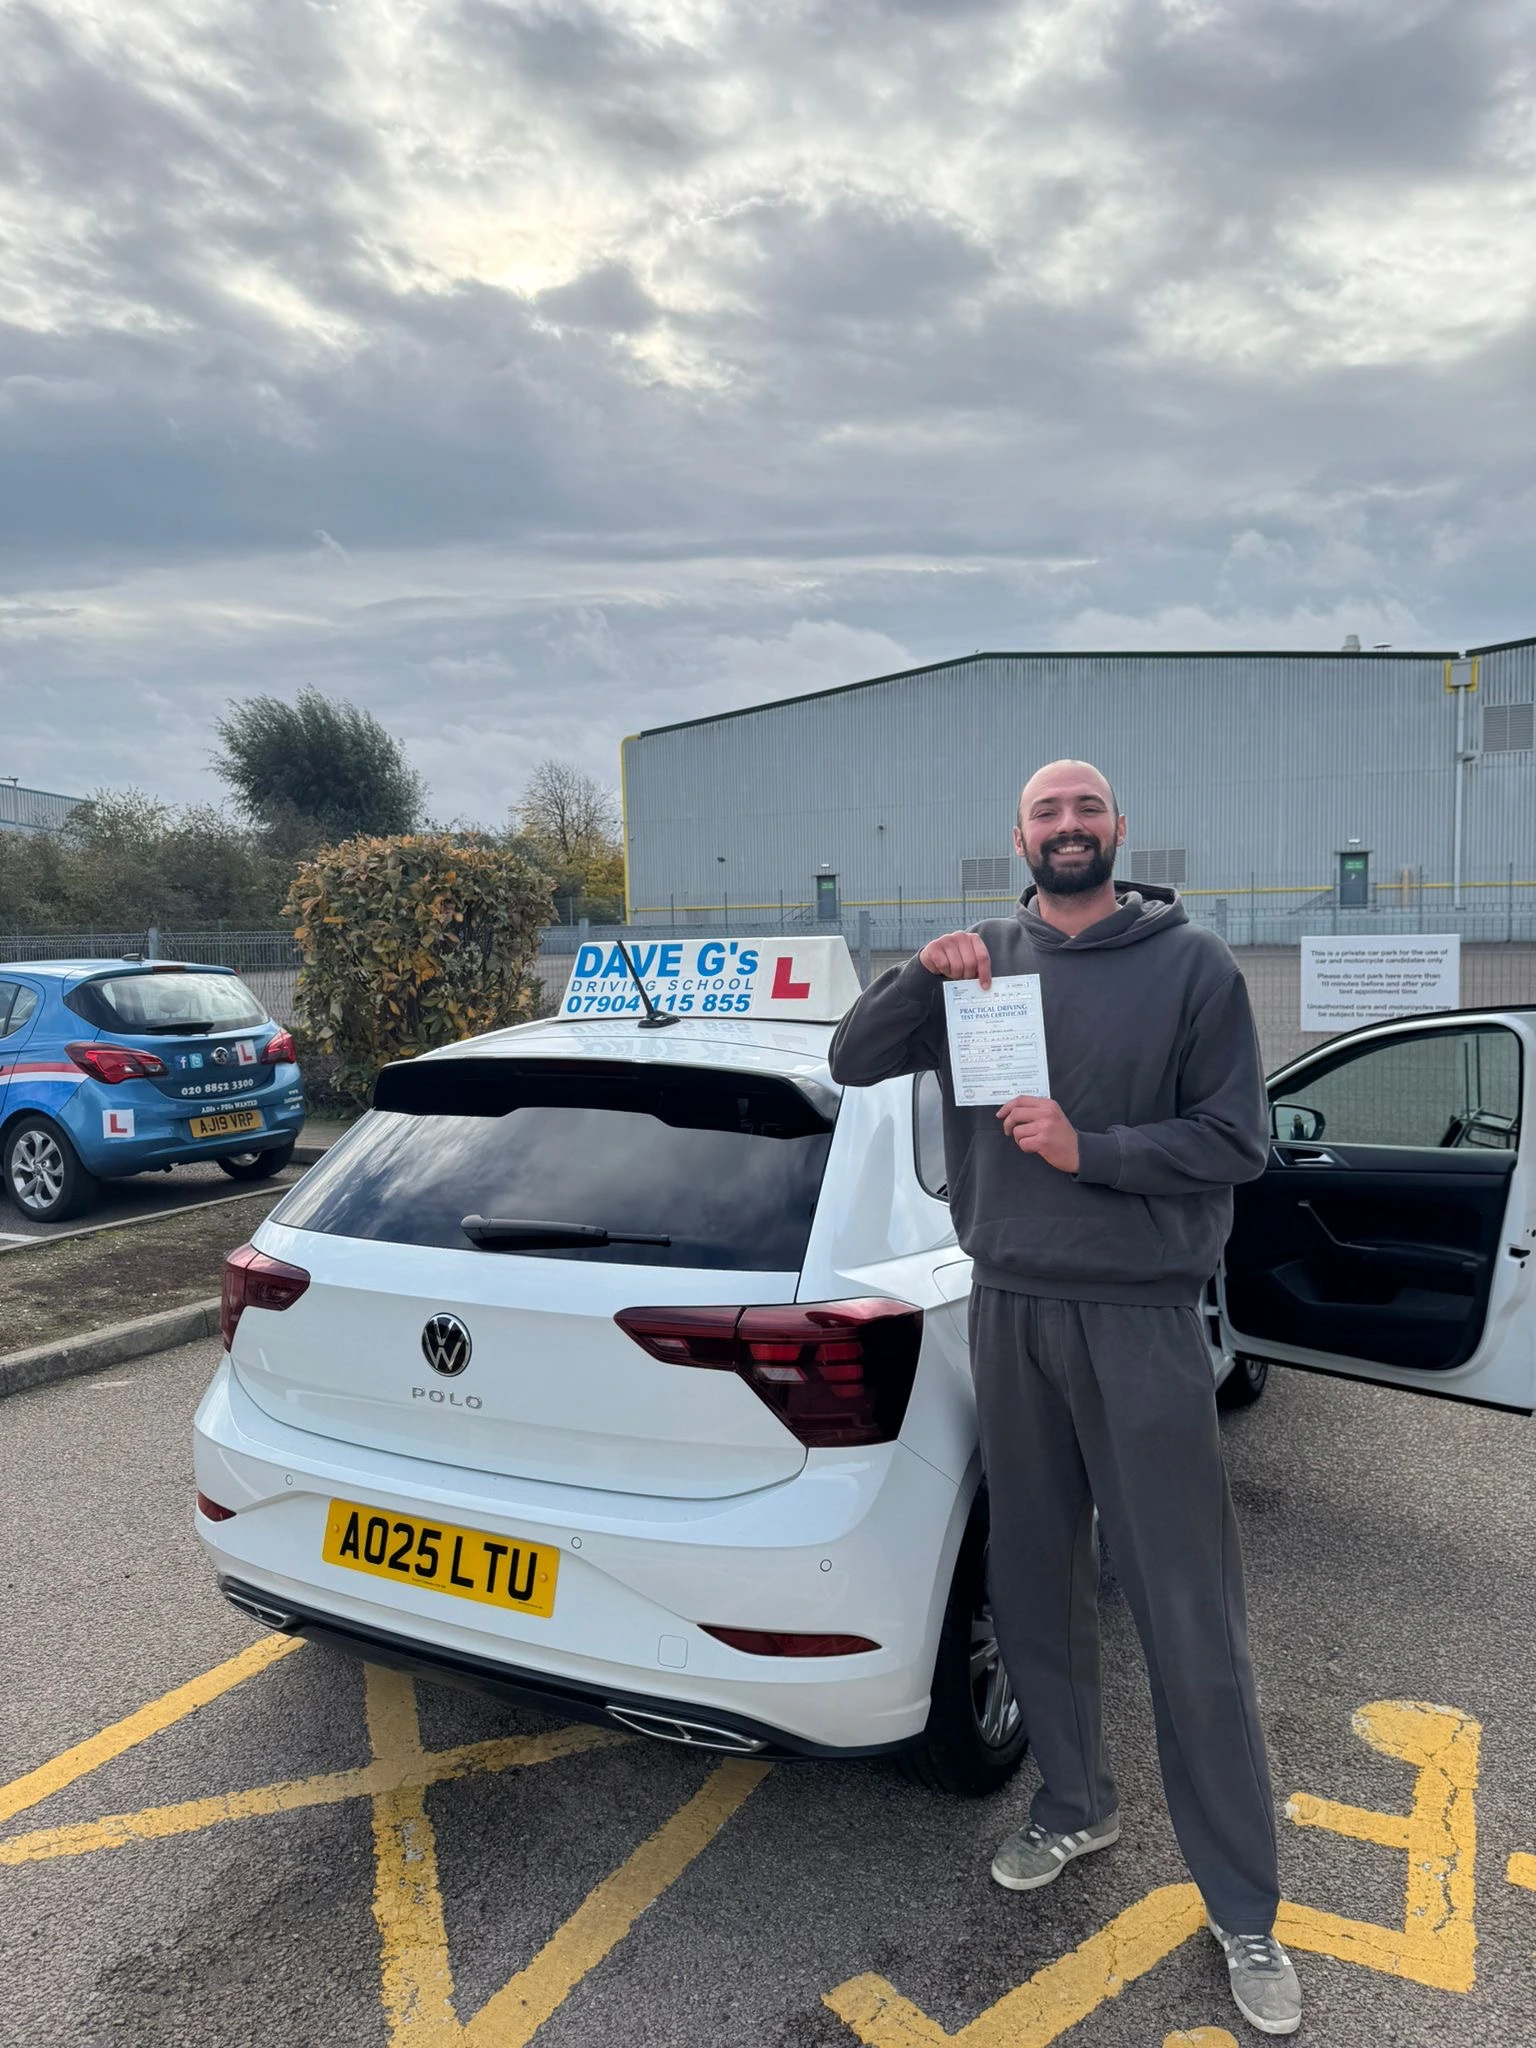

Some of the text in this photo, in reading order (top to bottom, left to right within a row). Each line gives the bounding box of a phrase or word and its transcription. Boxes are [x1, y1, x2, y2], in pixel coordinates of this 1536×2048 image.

[575, 942, 760, 978] DAVE G's
[668, 979, 754, 991] SCHOOL
[771, 957, 811, 999] L
[567, 994, 751, 1013] 07904 115 855
[960, 1003, 1028, 1014] PRACTICAL DRIVING
[961, 1010, 1028, 1021] TEST PASS CERTIFICATE
[241, 1044, 253, 1062] L
[181, 1079, 254, 1095] 020 8852 3300
[234, 1100, 258, 1109] WANTED
[110, 1114, 127, 1133] L
[200, 1112, 254, 1134] AJ19 VRP
[412, 1387, 483, 1409] POLO
[450, 1536, 538, 1602] LTU
